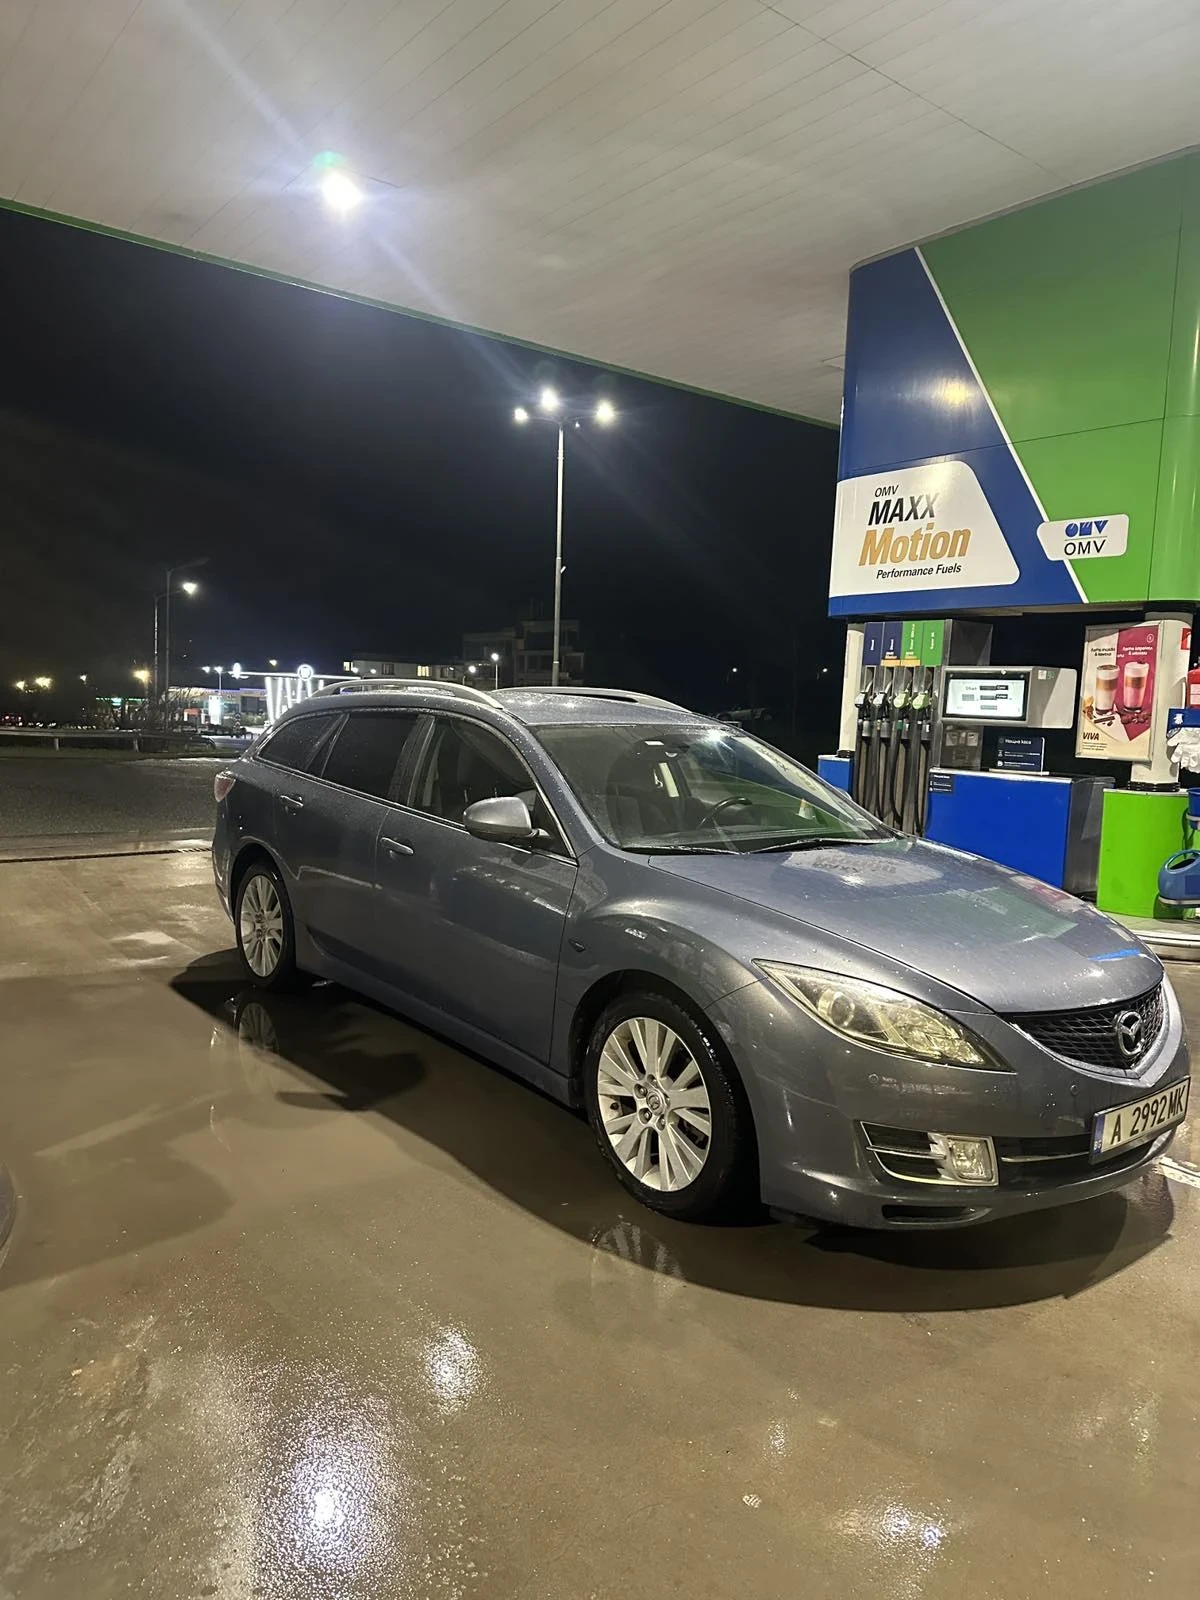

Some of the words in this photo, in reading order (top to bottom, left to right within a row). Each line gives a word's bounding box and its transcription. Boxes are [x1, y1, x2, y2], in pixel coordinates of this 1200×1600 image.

[874, 485, 899, 498] OMV
[868, 493, 939, 526] MAXX
[858, 522, 972, 566] Motion
[1064, 539, 1106, 556] OMV
[876, 566, 934, 579] Performance
[936, 563, 962, 575] Fuels
[1082, 732, 1100, 741] VIVA
[1111, 1114, 1122, 1145] A
[1130, 1095, 1167, 1137] 2992
[1167, 1084, 1186, 1119] MK
